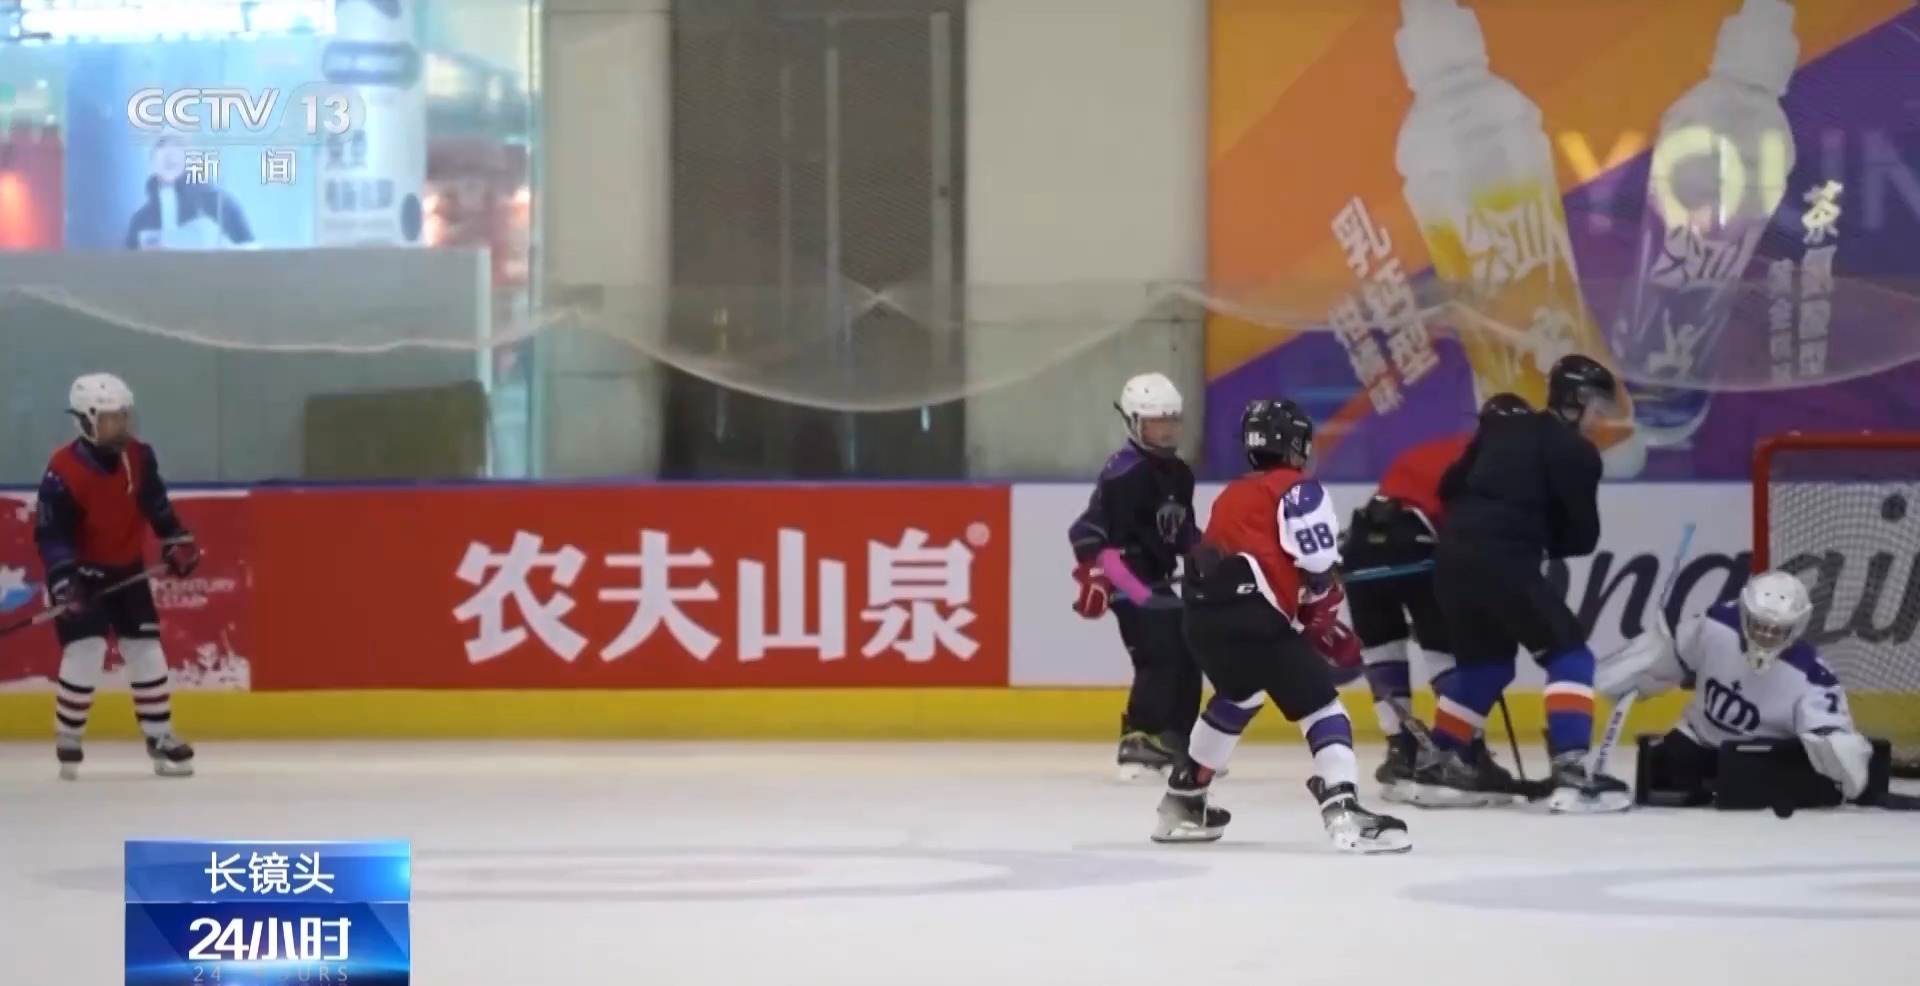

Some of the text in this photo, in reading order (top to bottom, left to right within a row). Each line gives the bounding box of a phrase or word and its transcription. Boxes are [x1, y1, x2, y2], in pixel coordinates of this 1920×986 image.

[1296, 522, 1334, 555] 88
[452, 527, 981, 664] 农夫山泉
